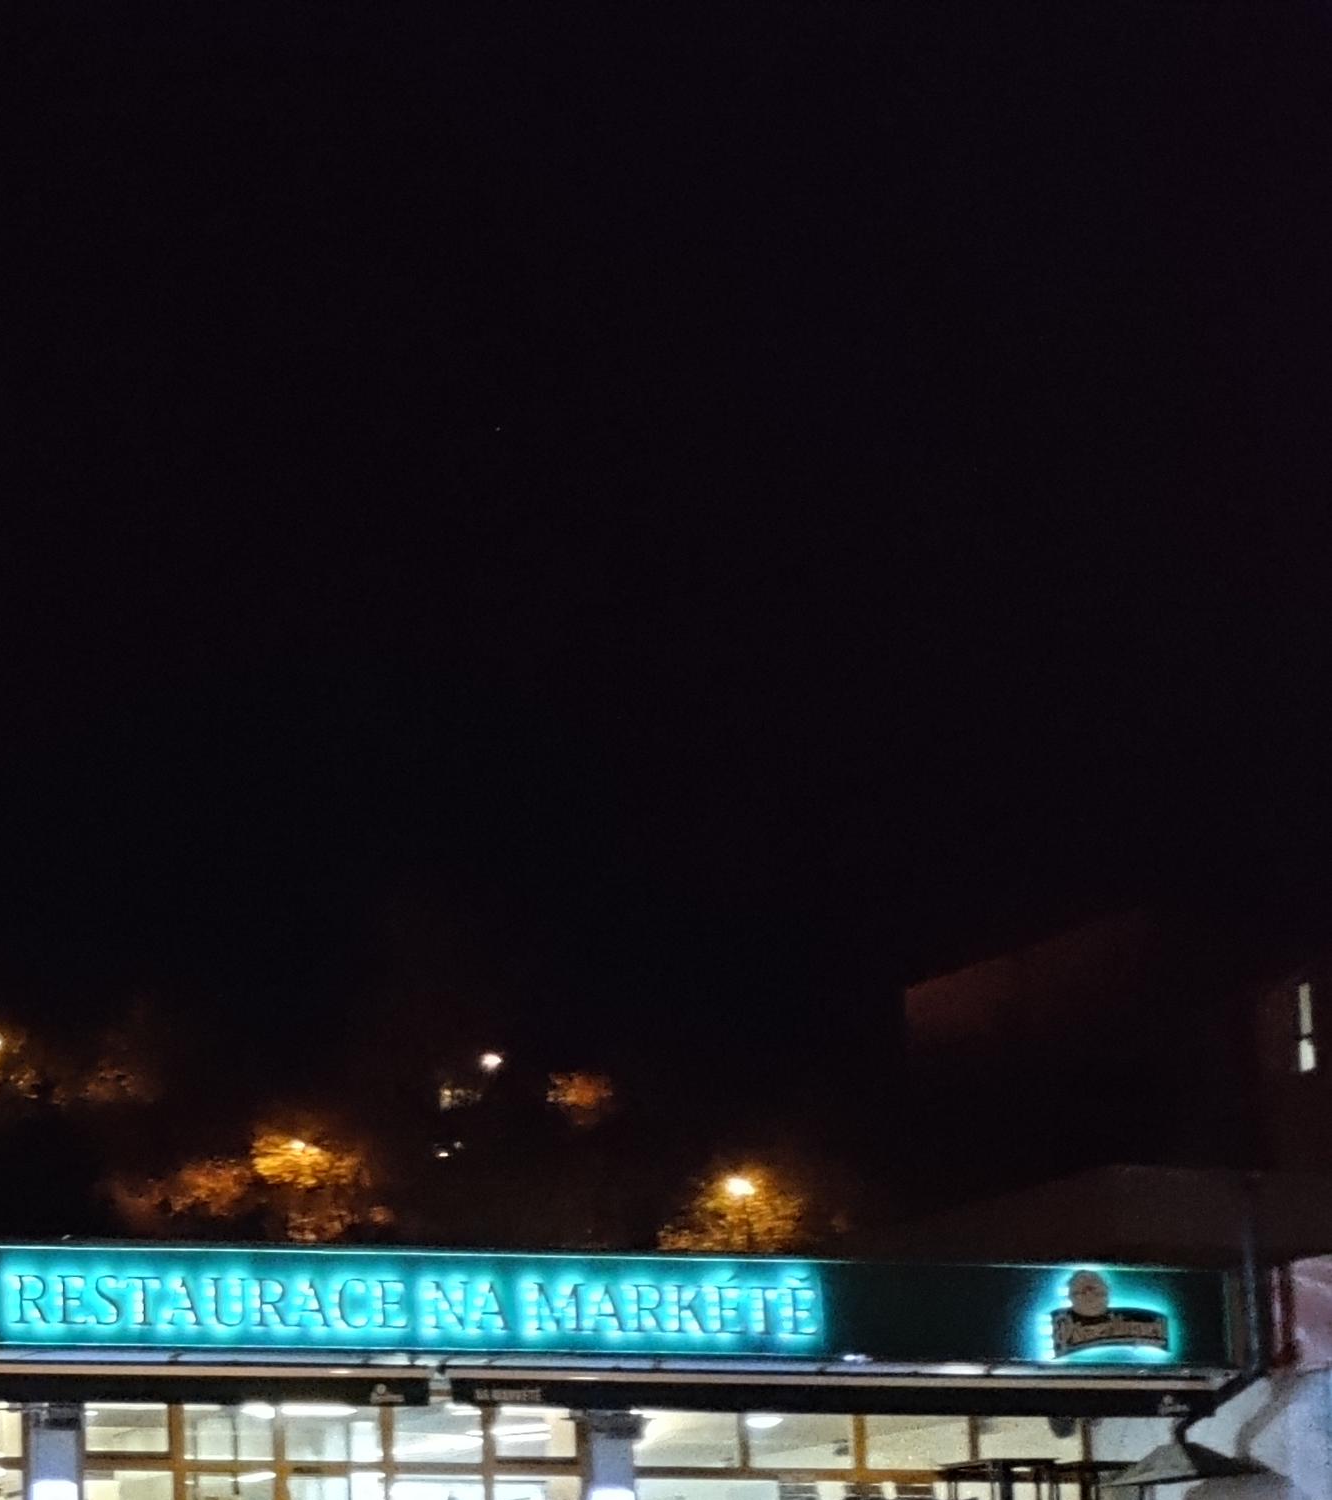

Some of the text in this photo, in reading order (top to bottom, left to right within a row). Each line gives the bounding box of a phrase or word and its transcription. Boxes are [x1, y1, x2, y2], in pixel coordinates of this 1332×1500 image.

[11, 1273, 819, 1336] RESTAURACE NA MARKÉTĚ
